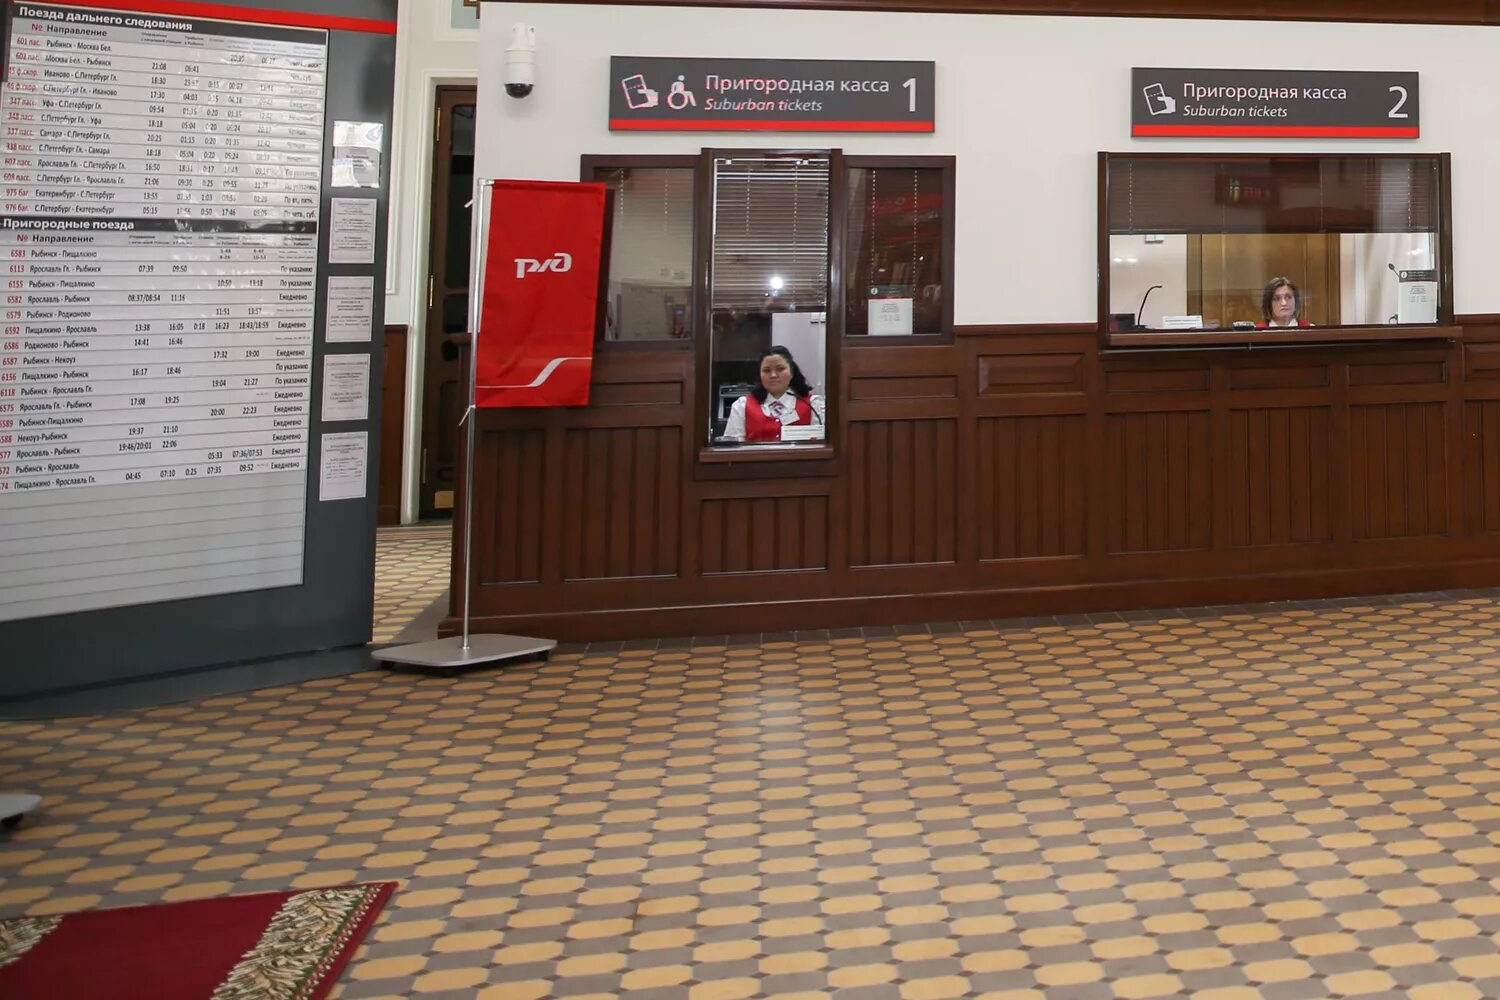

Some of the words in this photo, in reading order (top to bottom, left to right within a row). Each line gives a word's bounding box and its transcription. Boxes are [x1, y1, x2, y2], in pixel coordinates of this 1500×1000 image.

[18, 6, 64, 21] Поезда
[66, 11, 122, 26] дальнего
[123, 15, 193, 32] следования
[31, 23, 43, 32] №
[46, 24, 108, 37] Направление
[46, 40, 72, 49] Рыбинск
[77, 43, 99, 51] Москва
[705, 74, 835, 94] Пригородная
[840, 79, 890, 93] касса
[901, 77, 918, 112] 1
[1183, 82, 1298, 101] Пригородная
[1303, 87, 1347, 100] касса
[704, 98, 775, 112] Suburban
[778, 99, 823, 112] tickets
[1387, 86, 1409, 119] 2
[1183, 105, 1245, 118] Suburban
[1248, 105, 1288, 118] tickets
[3, 218, 90, 230] Пригородные
[92, 219, 134, 231] поезда
[16, 234, 28, 242] №
[32, 234, 94, 244] Направление
